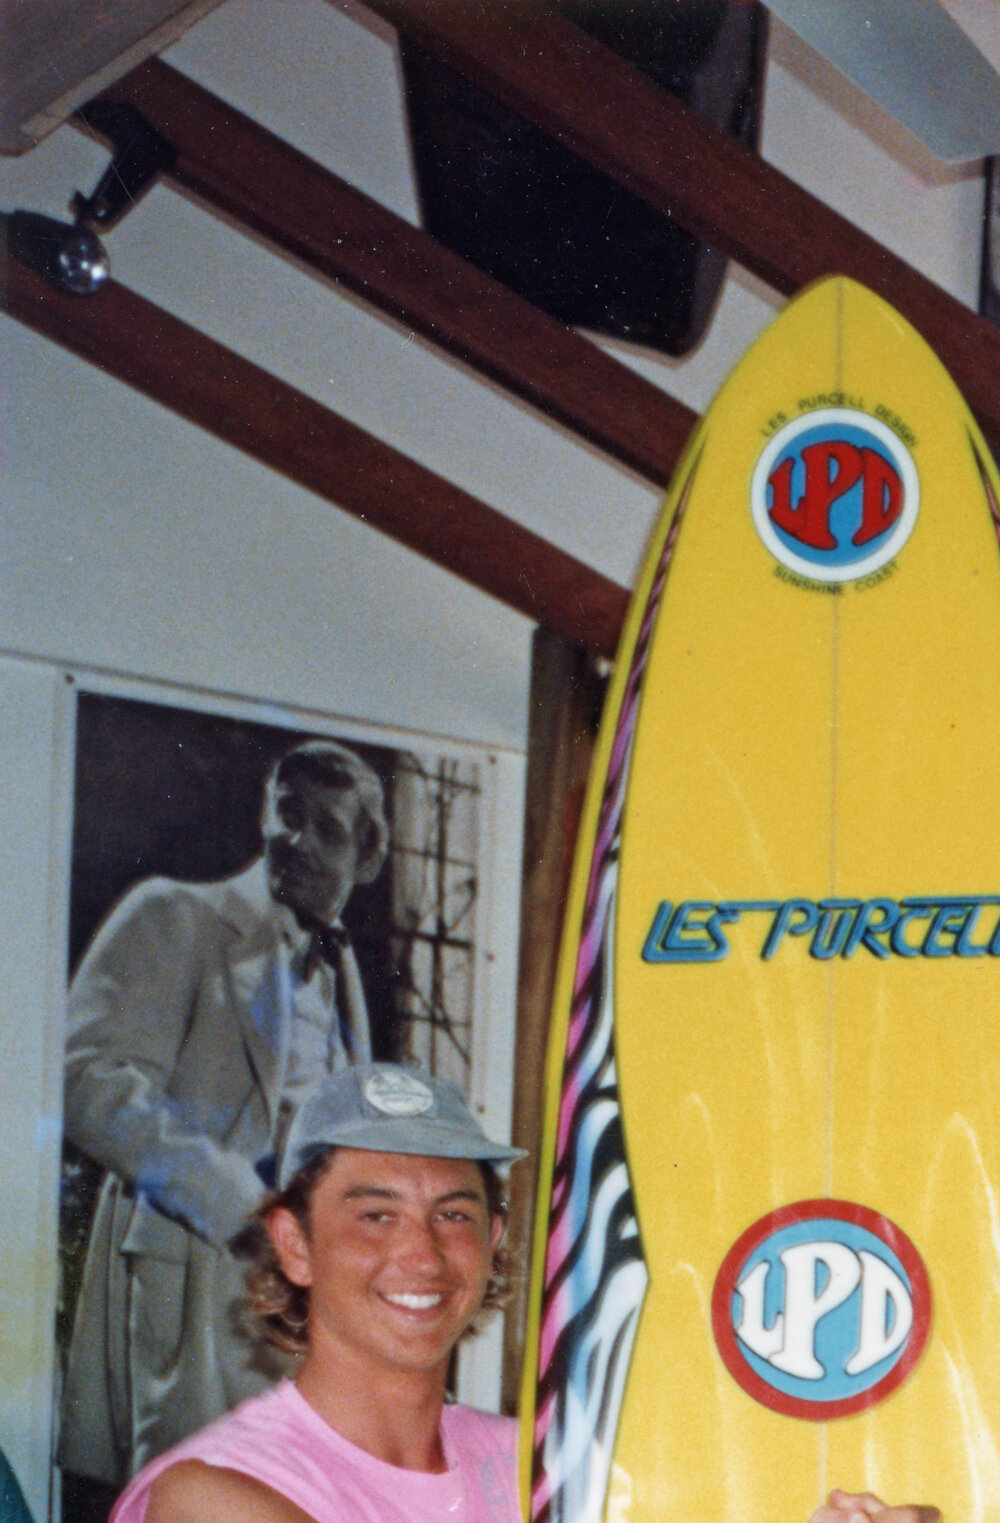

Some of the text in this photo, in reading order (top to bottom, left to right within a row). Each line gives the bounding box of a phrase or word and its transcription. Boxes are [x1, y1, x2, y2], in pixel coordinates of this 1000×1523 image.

[761, 392, 919, 448] LES PURCELL DESIGN
[767, 440, 905, 550] LPD
[773, 560, 899, 597] SUNSHINE COAST
[641, 899, 740, 964] LES
[732, 1240, 913, 1381] LPD
